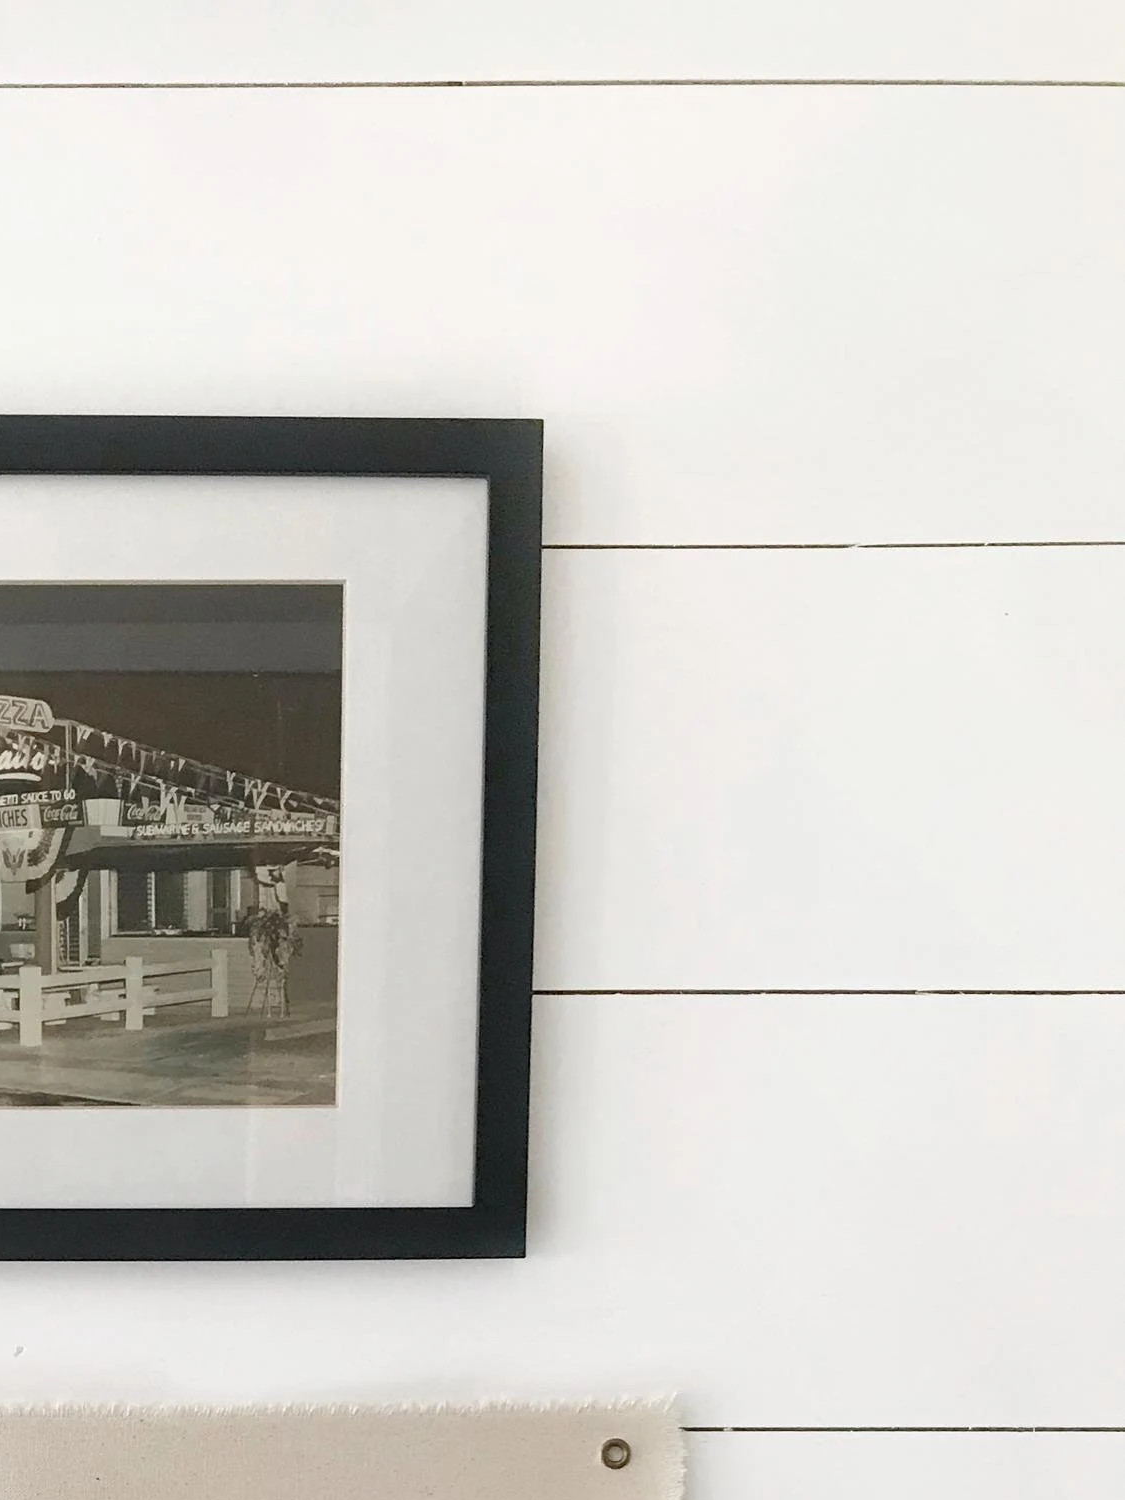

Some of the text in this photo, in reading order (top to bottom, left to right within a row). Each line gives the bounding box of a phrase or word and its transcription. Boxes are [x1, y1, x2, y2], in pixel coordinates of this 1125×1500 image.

[21, 790, 48, 804] SAUCE
[50, 790, 62, 802] TO
[63, 788, 76, 800] GO
[202, 820, 251, 834] SAUSAGE
